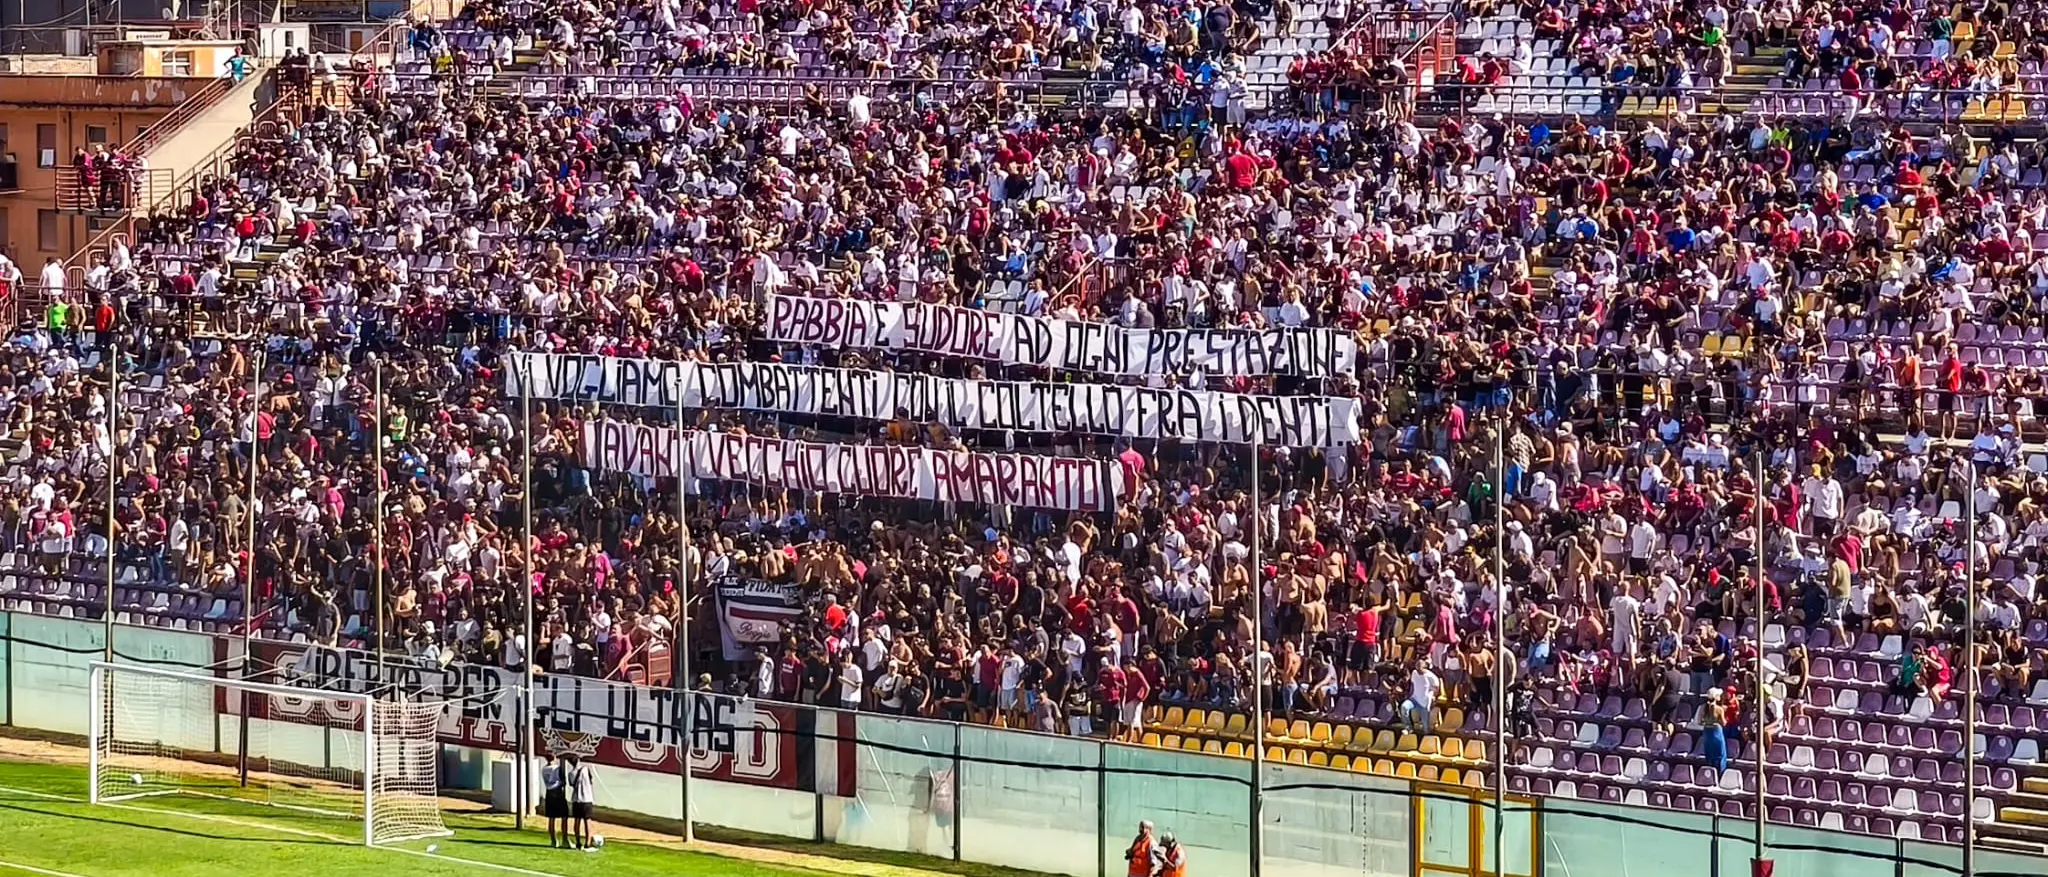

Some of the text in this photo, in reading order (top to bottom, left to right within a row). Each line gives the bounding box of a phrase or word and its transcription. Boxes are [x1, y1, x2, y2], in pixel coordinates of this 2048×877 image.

[771, 296, 867, 348] RABBIA
[874, 304, 889, 348] E
[903, 301, 1000, 358] SUDORE
[1014, 314, 1053, 365] AD
[1065, 321, 1129, 374] OGNI
[510, 353, 536, 398] VI
[545, 354, 681, 406] VOGLIAMO
[698, 362, 879, 418] COMBATTENTI
[893, 372, 939, 422] CON
[945, 379, 968, 428] IL
[978, 380, 1124, 434] COLTELLO
[1136, 387, 1201, 438] FRA
[1219, 393, 1228, 441] I
[707, 431, 829, 491] VECCHIO
[838, 445, 922, 497] CUORE
[932, 449, 1099, 511] AMARANTO
[442, 665, 502, 720] PER
